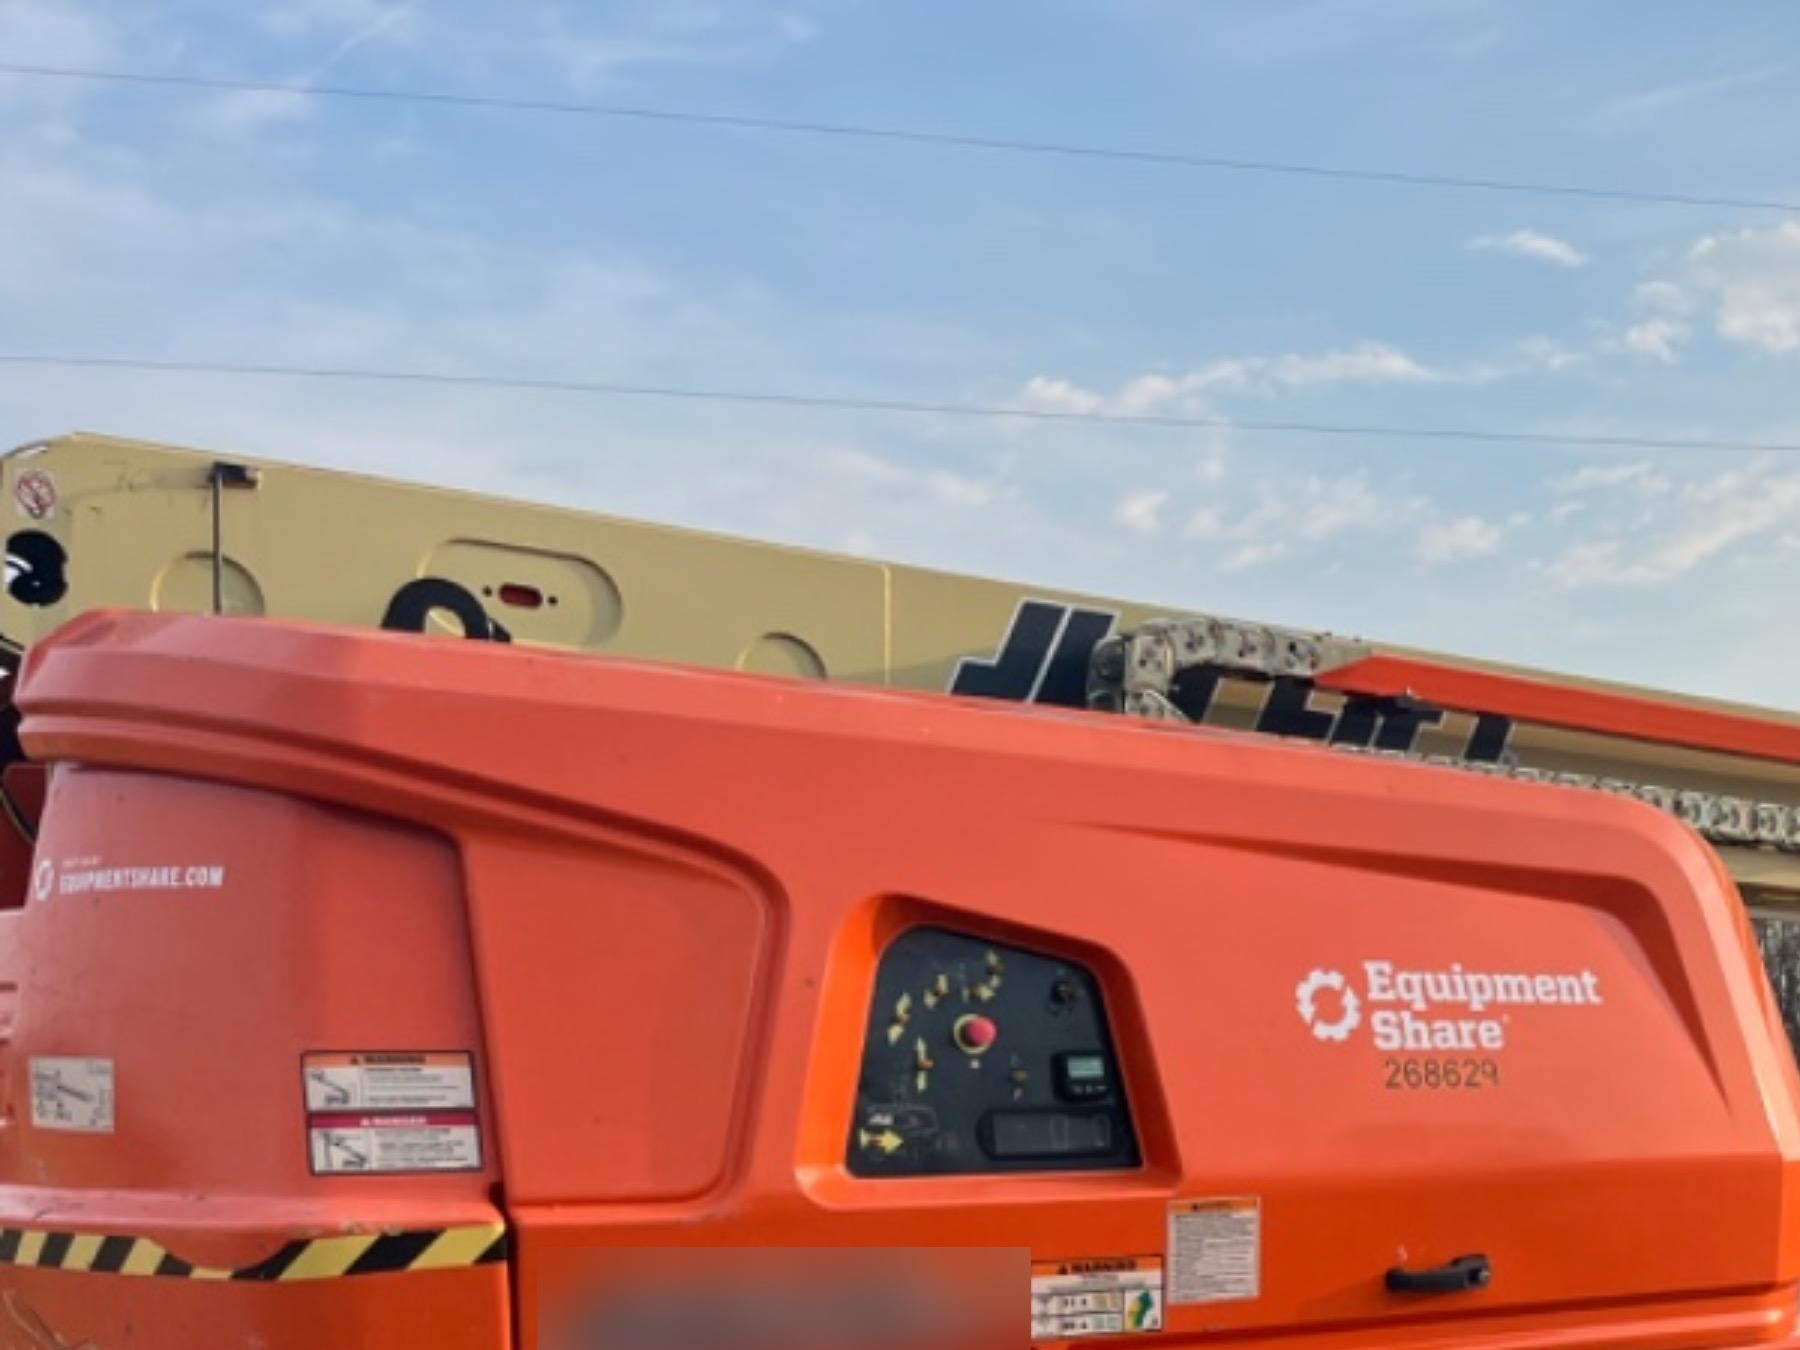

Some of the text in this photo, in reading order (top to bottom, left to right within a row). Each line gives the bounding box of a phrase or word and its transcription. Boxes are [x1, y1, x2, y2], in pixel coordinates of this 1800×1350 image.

[1363, 960, 1604, 1012] Equipment
[1371, 1009, 1504, 1050] Share
[1384, 1059, 1500, 1090] 268629
